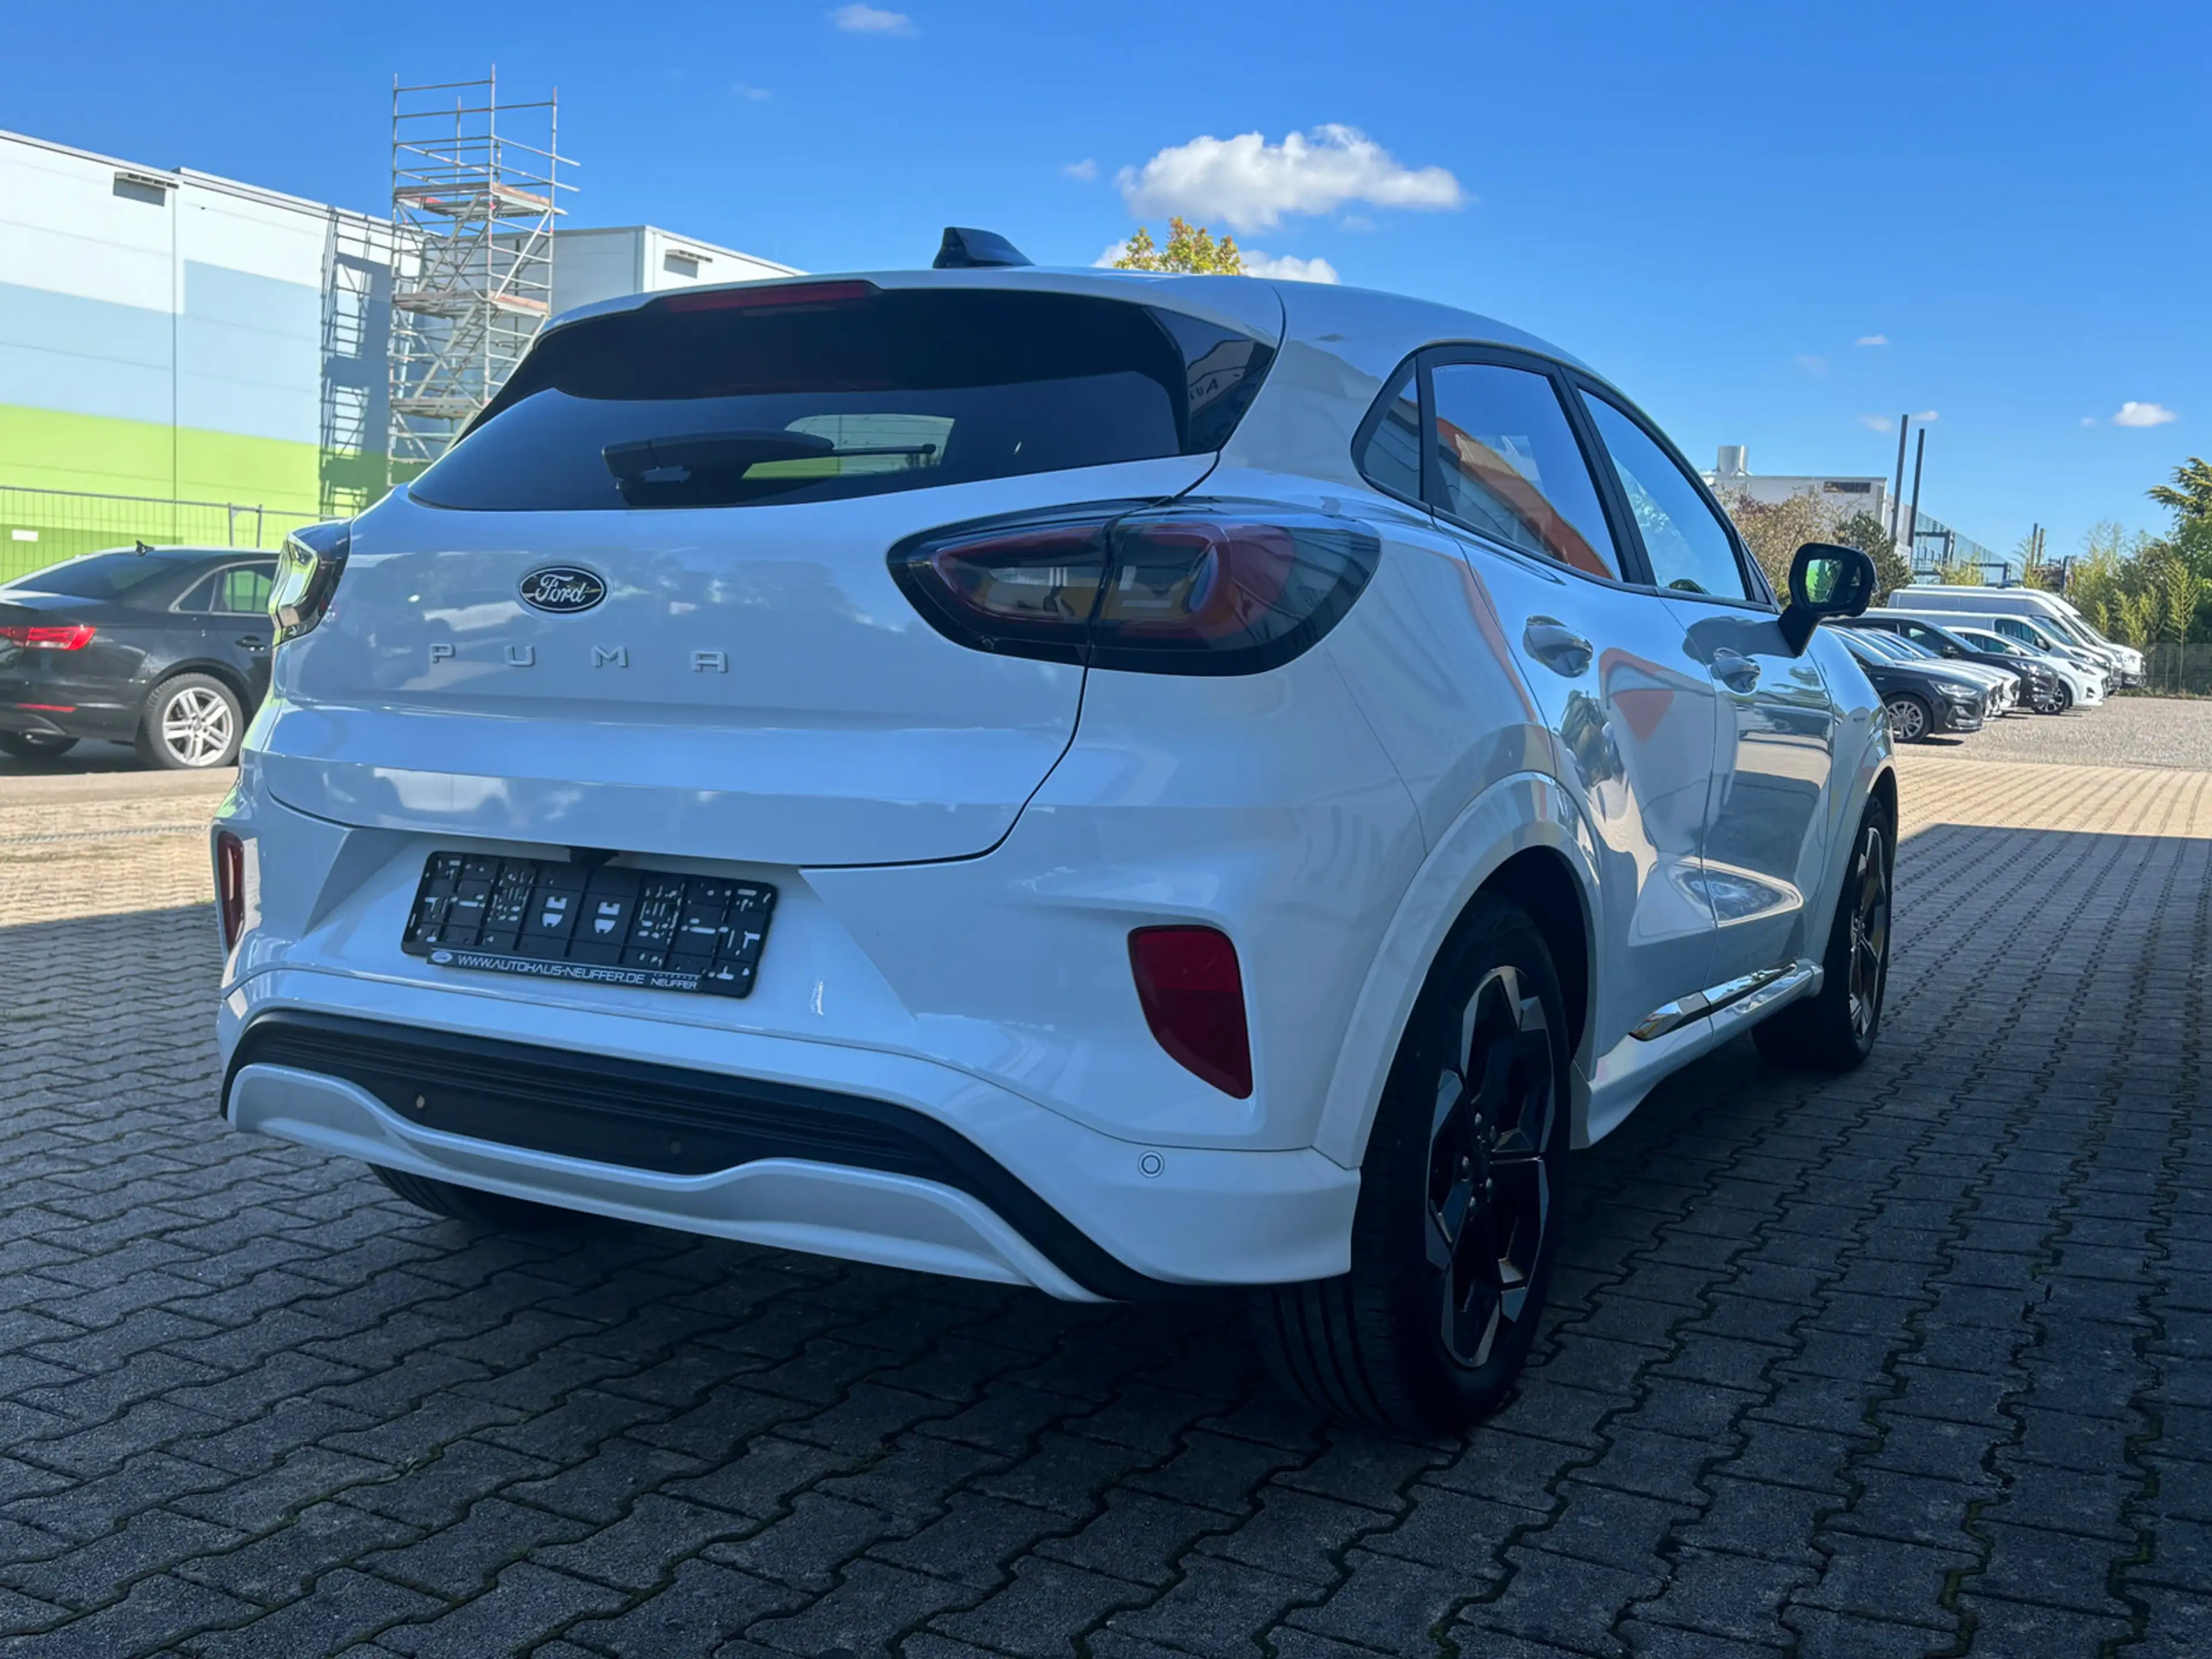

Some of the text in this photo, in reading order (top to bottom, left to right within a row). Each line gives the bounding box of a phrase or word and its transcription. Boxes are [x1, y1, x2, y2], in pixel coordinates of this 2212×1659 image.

[535, 574, 587, 603] Ford
[430, 643, 728, 673] PUMA
[651, 978, 698, 990] NEUFFER
